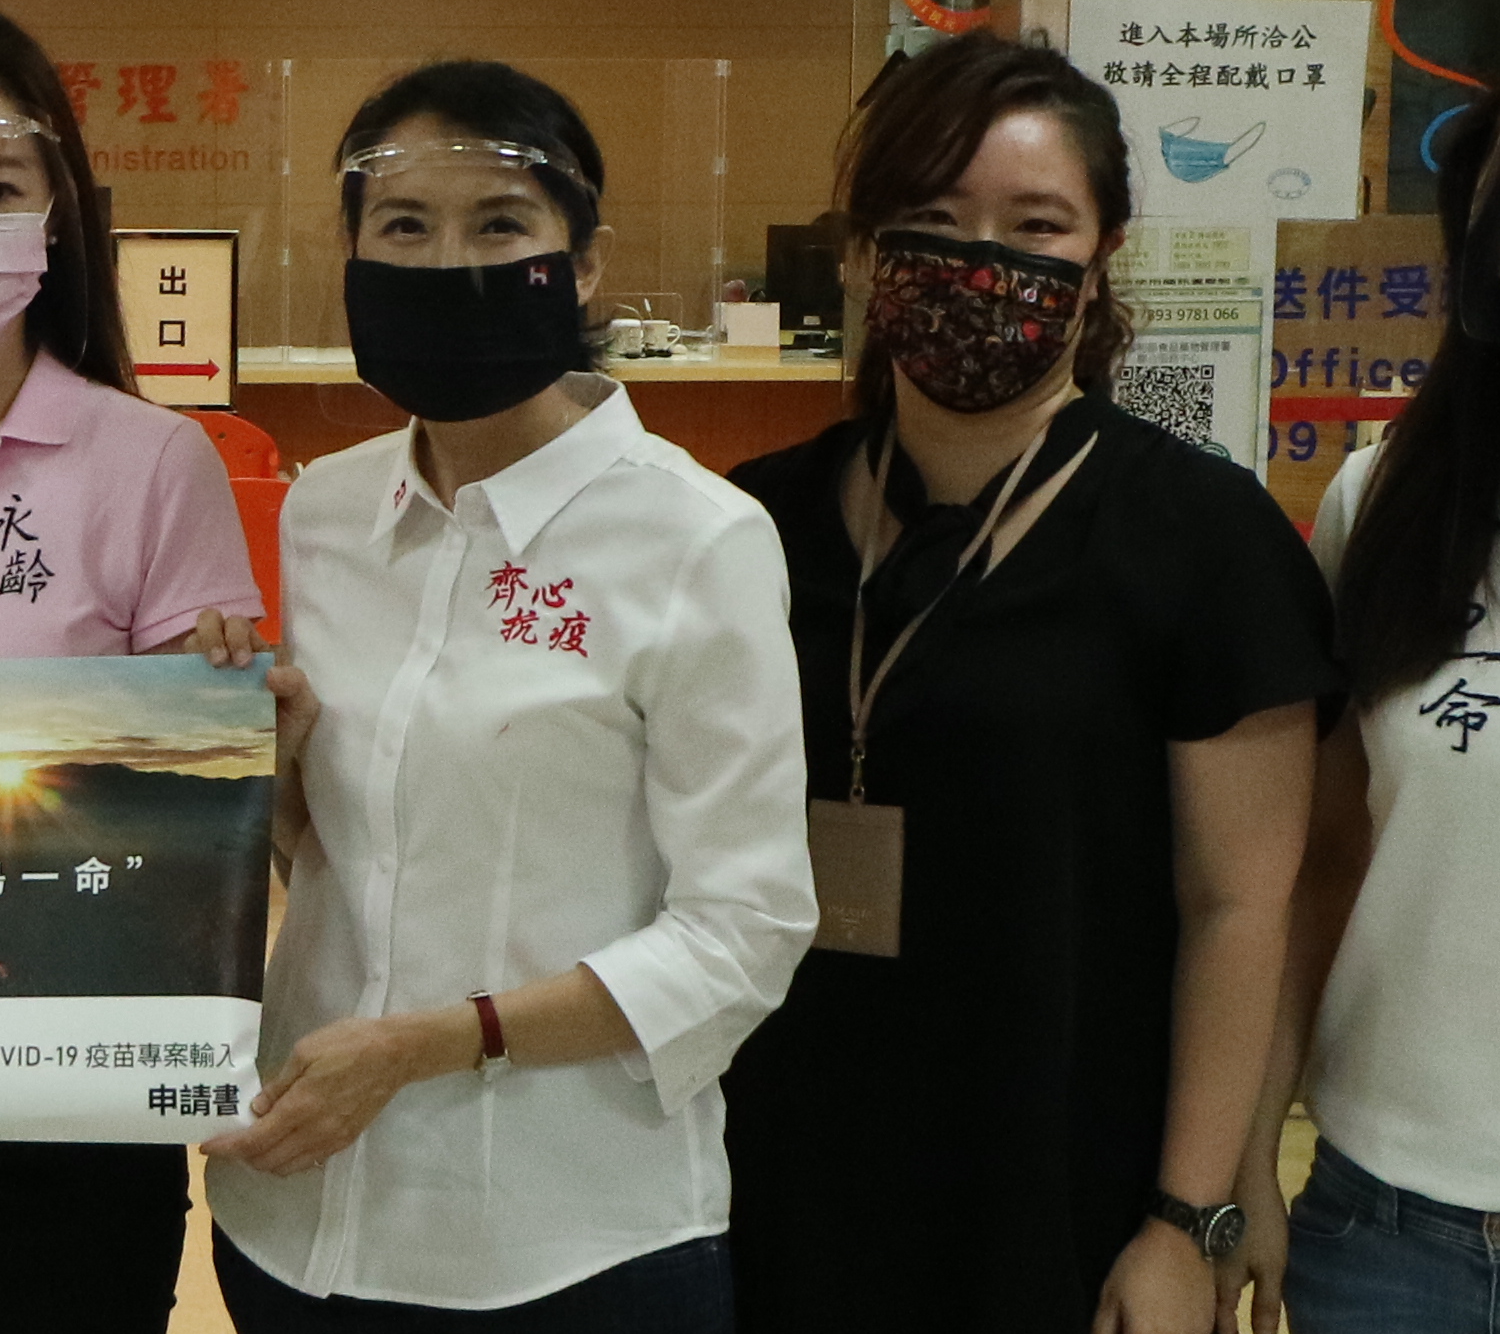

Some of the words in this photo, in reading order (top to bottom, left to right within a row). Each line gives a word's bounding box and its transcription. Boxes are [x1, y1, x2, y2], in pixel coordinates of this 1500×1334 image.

[1119, 21, 1317, 50] 進入本場所洽公
[1103, 61, 1326, 92] 敬請全程配戴口罩
[159, 265, 187, 347] 出口
[1273, 266, 1447, 319] 送件受
[1213, 307, 1240, 320] 066
[500, 607, 592, 658] 抗疫
[85, 1041, 237, 1070] 疫苗專案輸入
[147, 1082, 241, 1117] 申請書
